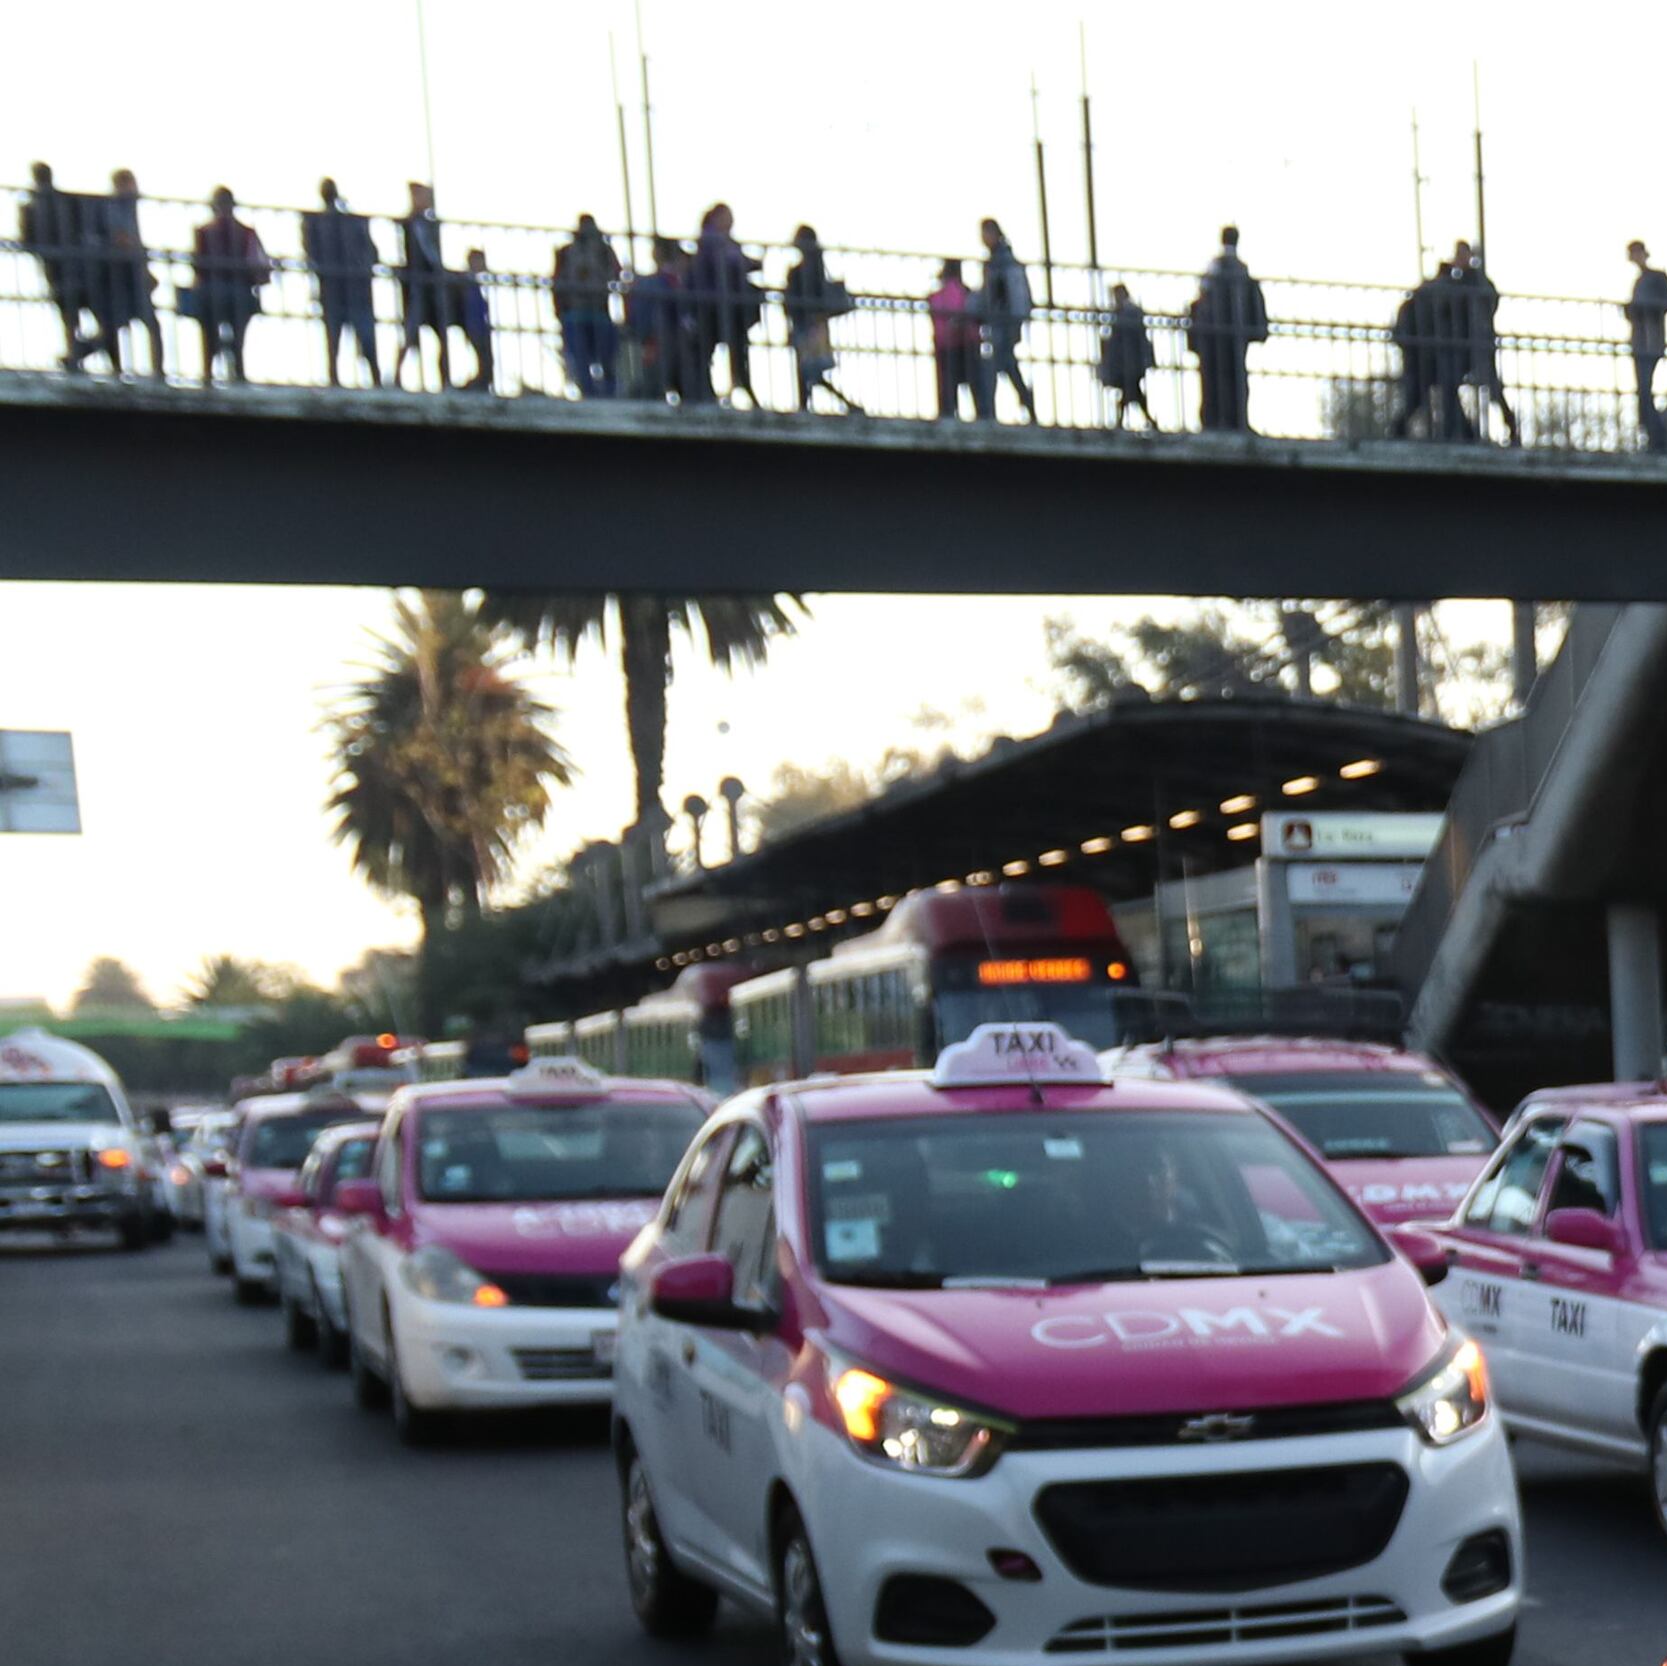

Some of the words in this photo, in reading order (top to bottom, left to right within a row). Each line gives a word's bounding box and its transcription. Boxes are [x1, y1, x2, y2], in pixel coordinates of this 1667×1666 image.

[990, 1031, 1056, 1055] TAXI
[1030, 1305, 1347, 1349] CDMX
[1551, 1296, 1586, 1338] TAXI
